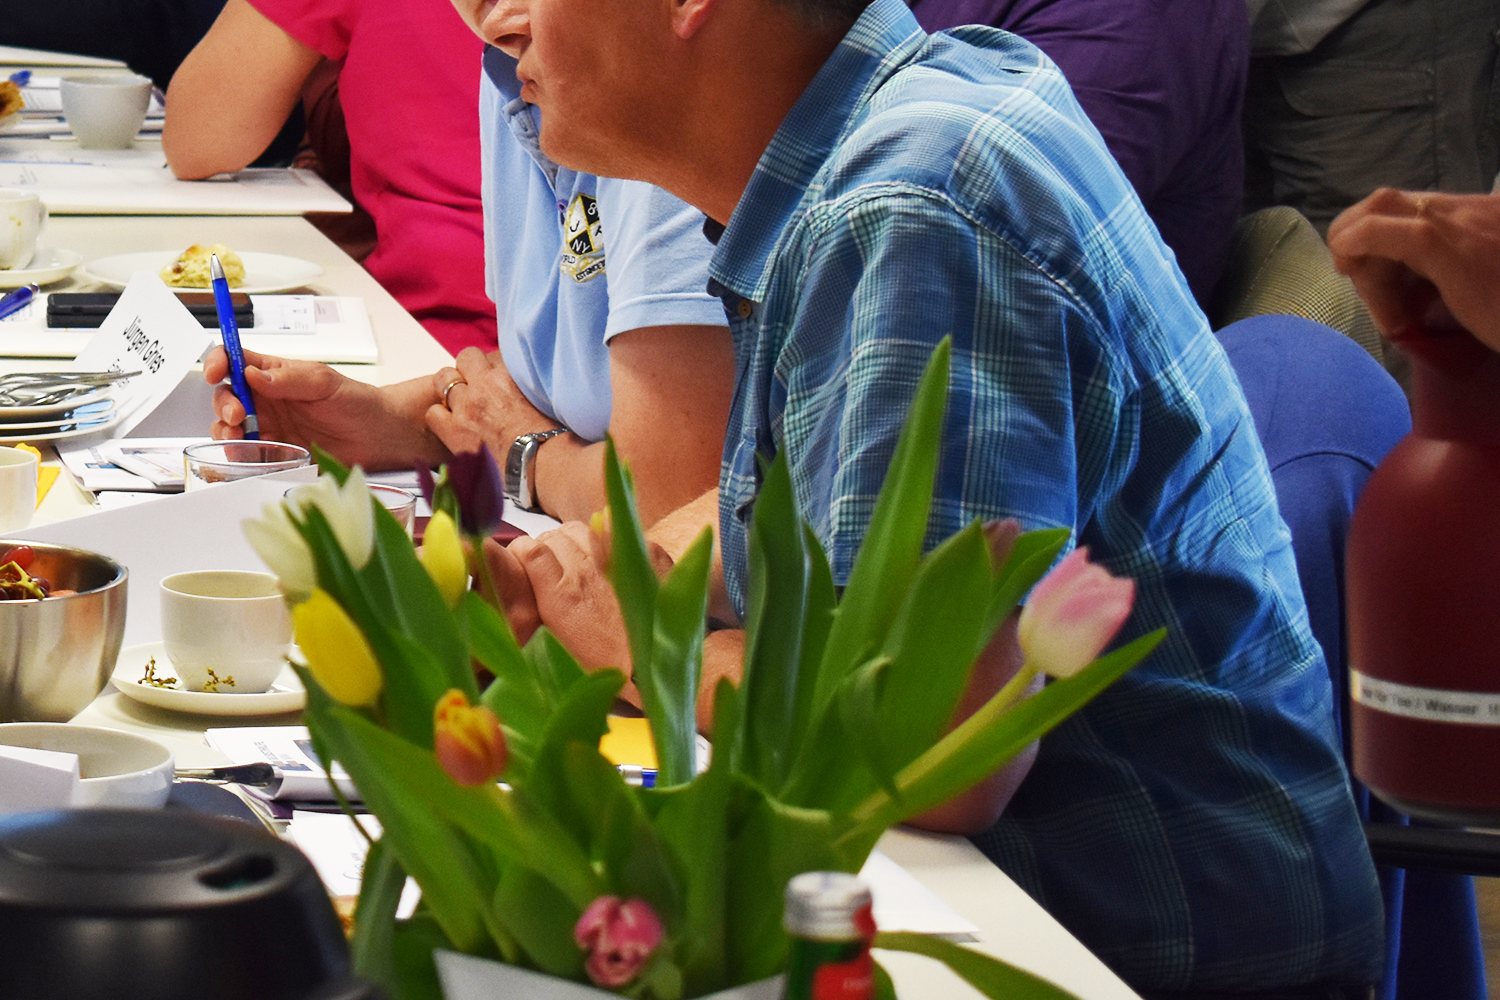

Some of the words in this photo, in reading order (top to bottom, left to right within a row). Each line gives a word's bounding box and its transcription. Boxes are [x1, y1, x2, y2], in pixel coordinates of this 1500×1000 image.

[122, 314, 150, 355] Jürgen
[142, 338, 166, 375] Gries
[1425, 699, 1480, 715] Wasser
